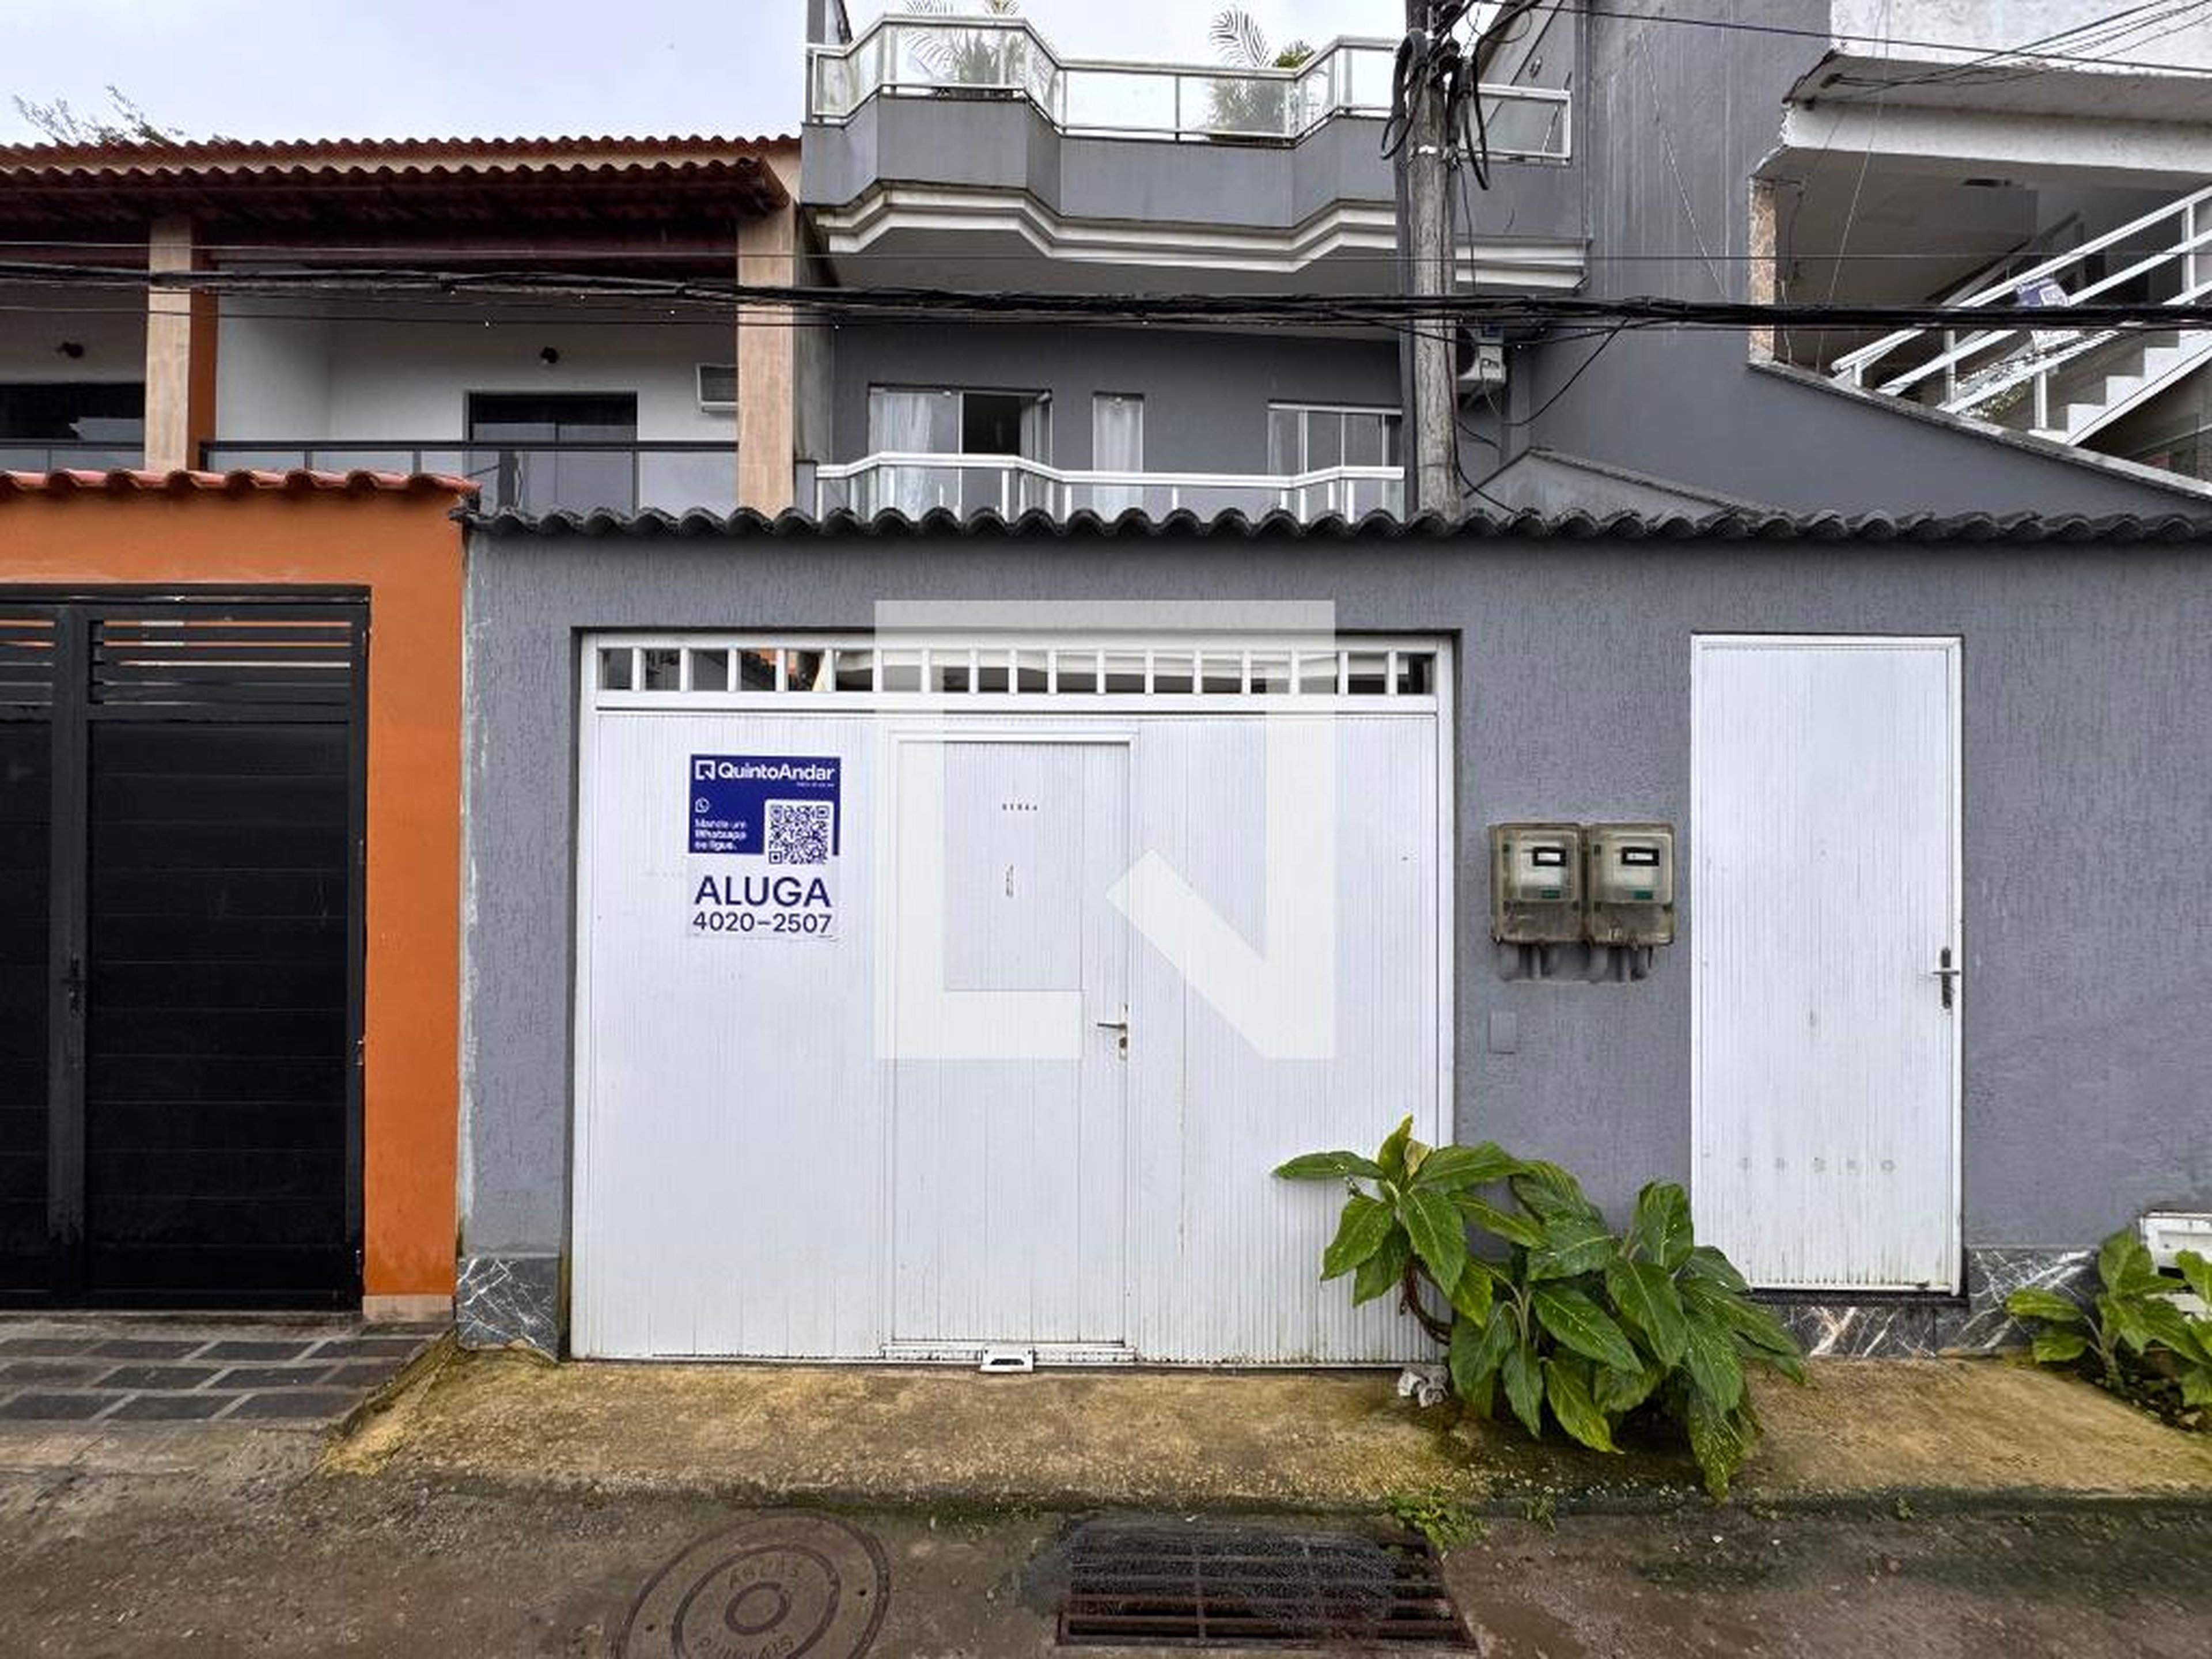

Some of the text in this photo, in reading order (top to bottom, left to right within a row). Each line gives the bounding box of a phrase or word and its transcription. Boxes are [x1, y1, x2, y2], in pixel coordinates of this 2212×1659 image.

[718, 762, 835, 781] QuintoAndar
[695, 875, 832, 908] ALUGA
[693, 911, 832, 933] 4020-2507
